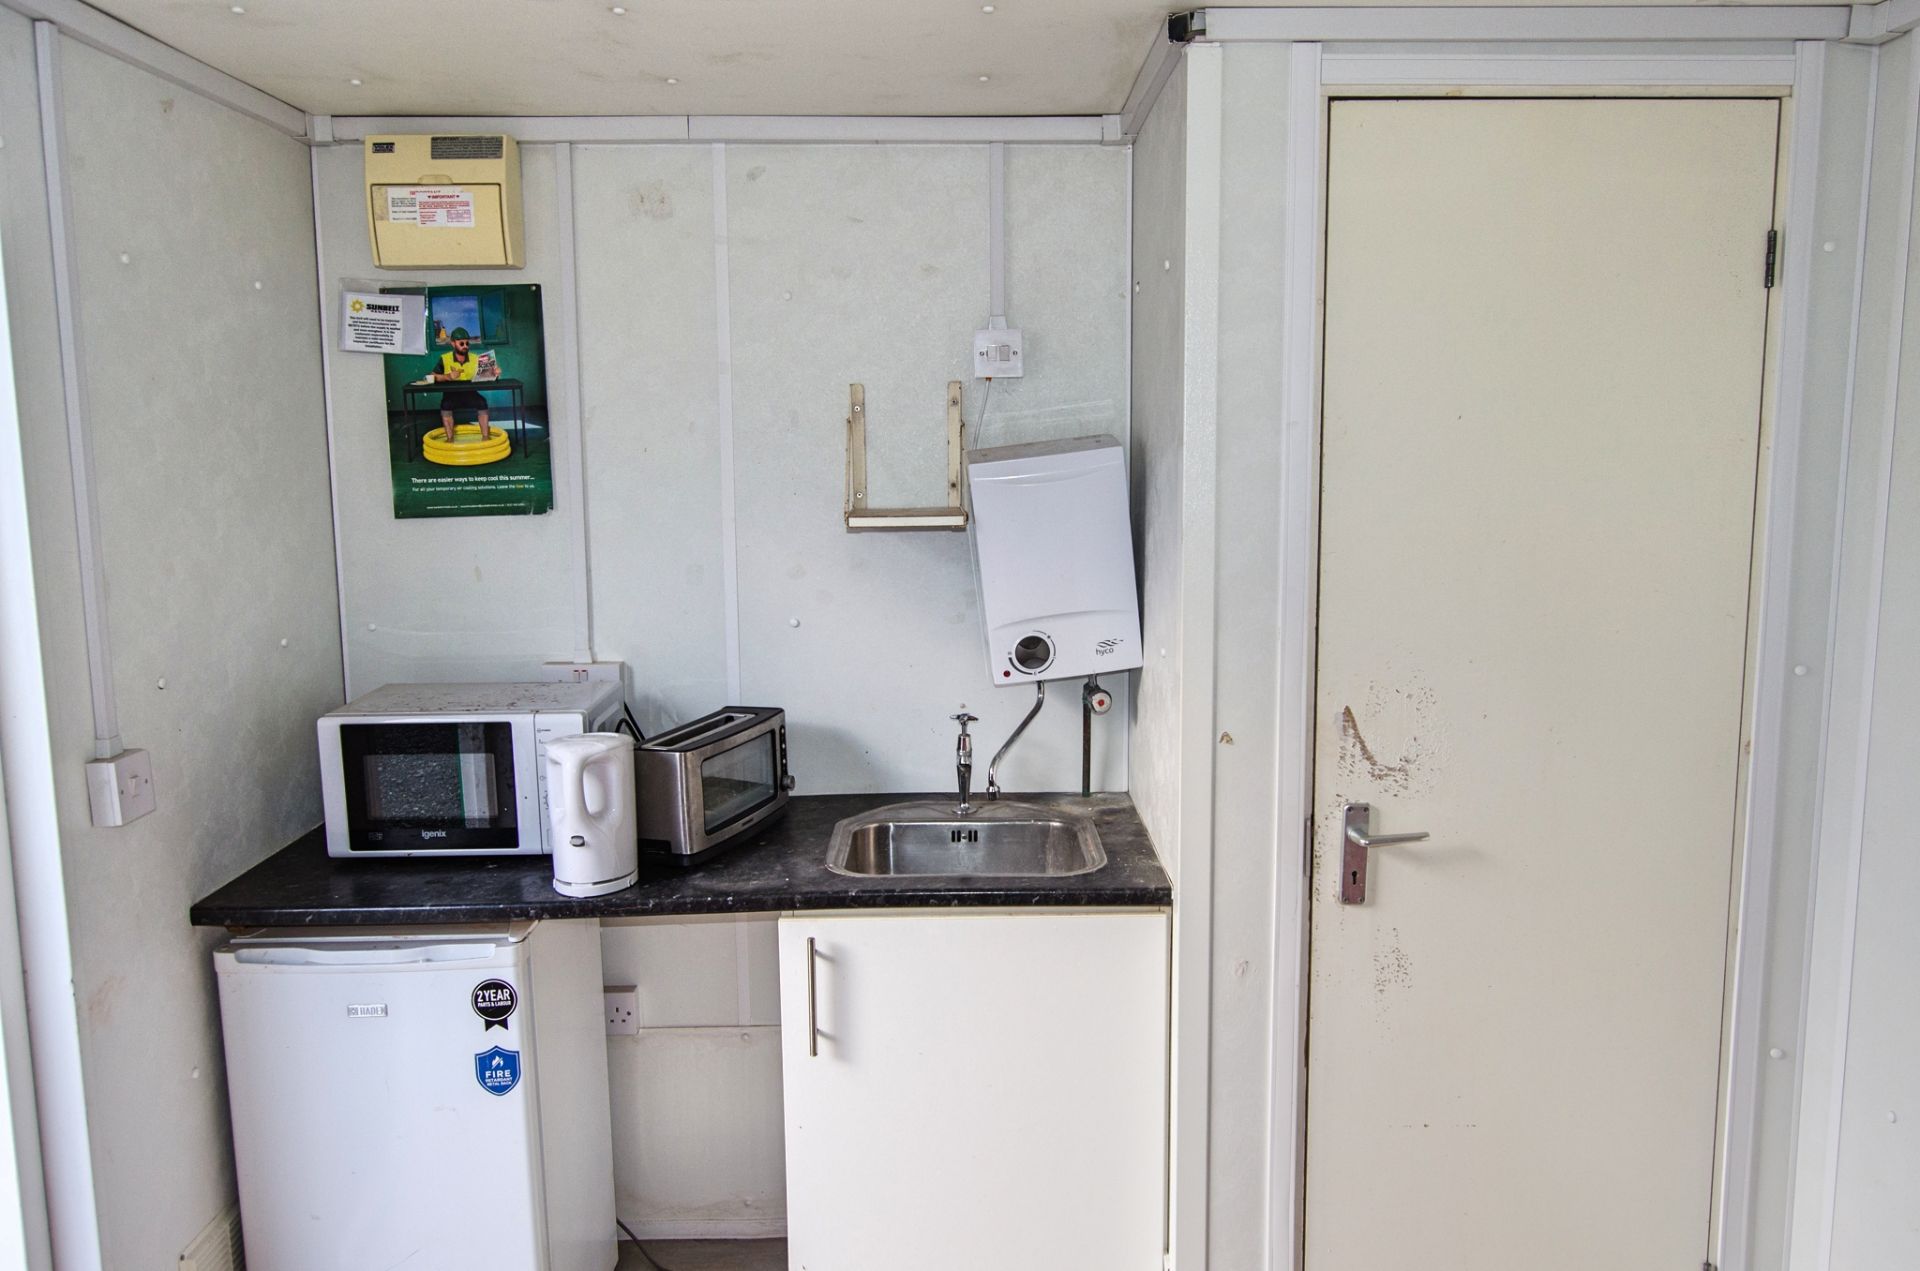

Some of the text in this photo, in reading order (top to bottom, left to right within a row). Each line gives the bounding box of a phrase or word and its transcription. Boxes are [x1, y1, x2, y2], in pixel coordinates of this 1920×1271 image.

[366, 303, 400, 312] SUNBELT
[1095, 647, 1114, 656] hyco
[421, 829, 446, 839] igenix
[485, 1069, 511, 1078] FIRE
